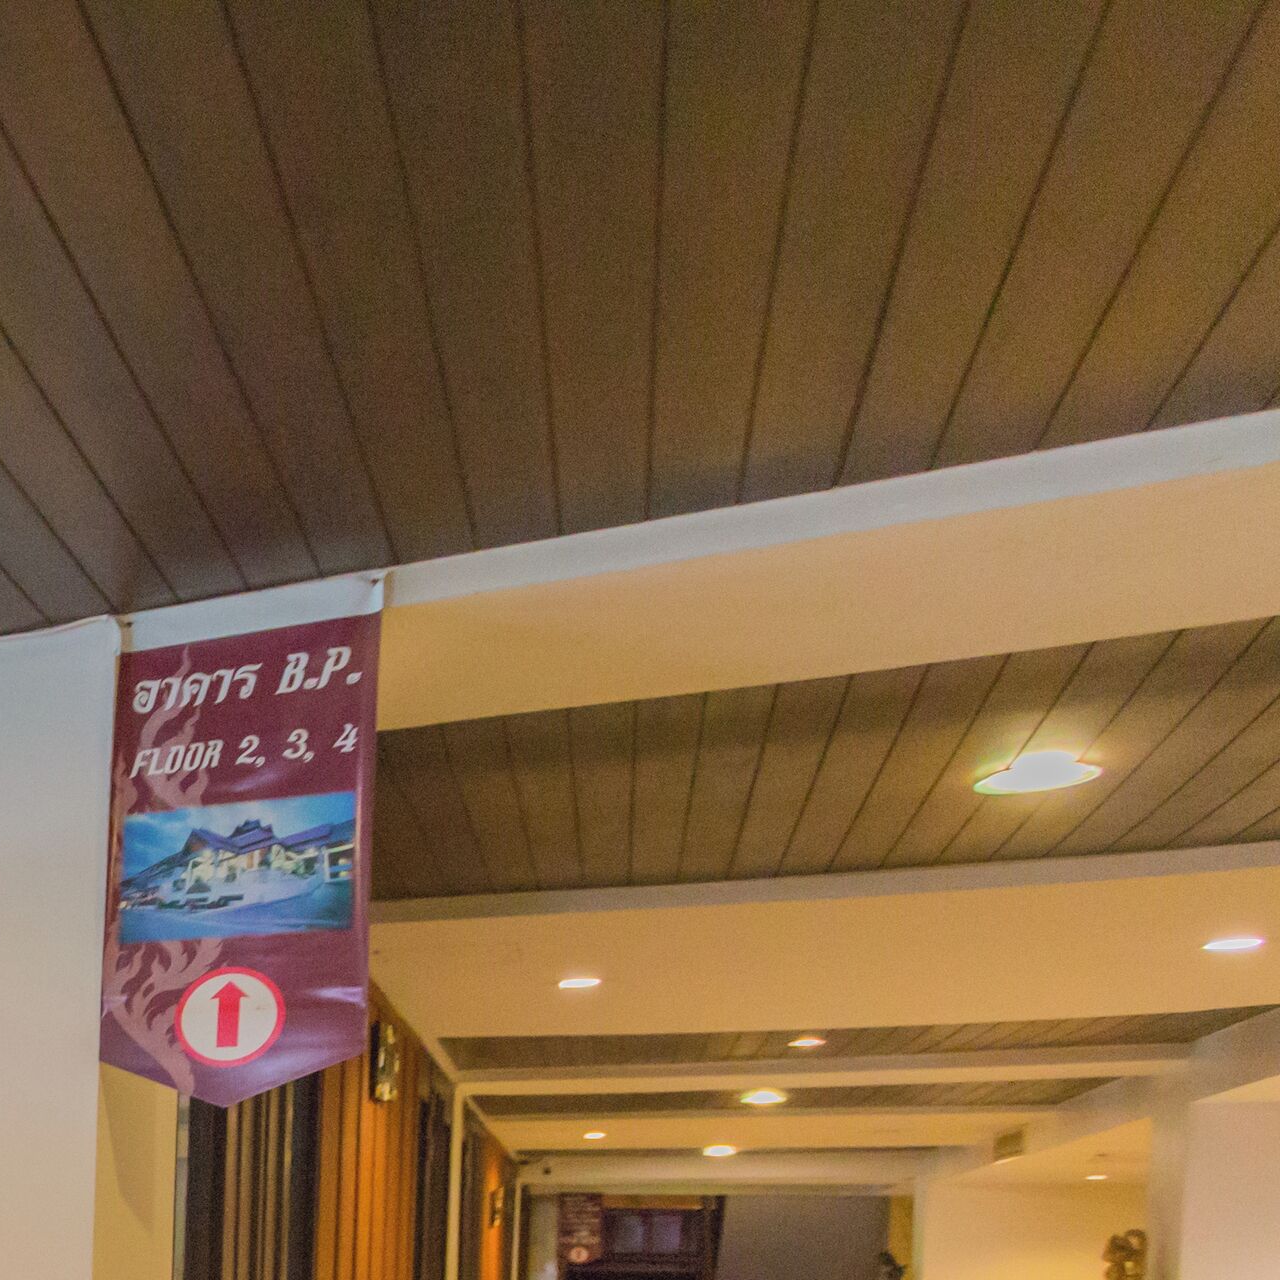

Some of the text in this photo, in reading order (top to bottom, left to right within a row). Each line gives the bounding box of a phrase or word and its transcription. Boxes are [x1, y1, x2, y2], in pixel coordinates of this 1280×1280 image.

[132, 646, 363, 714] อาคาร B.P.
[129, 723, 359, 779] FLOOR 2, 3, 4
